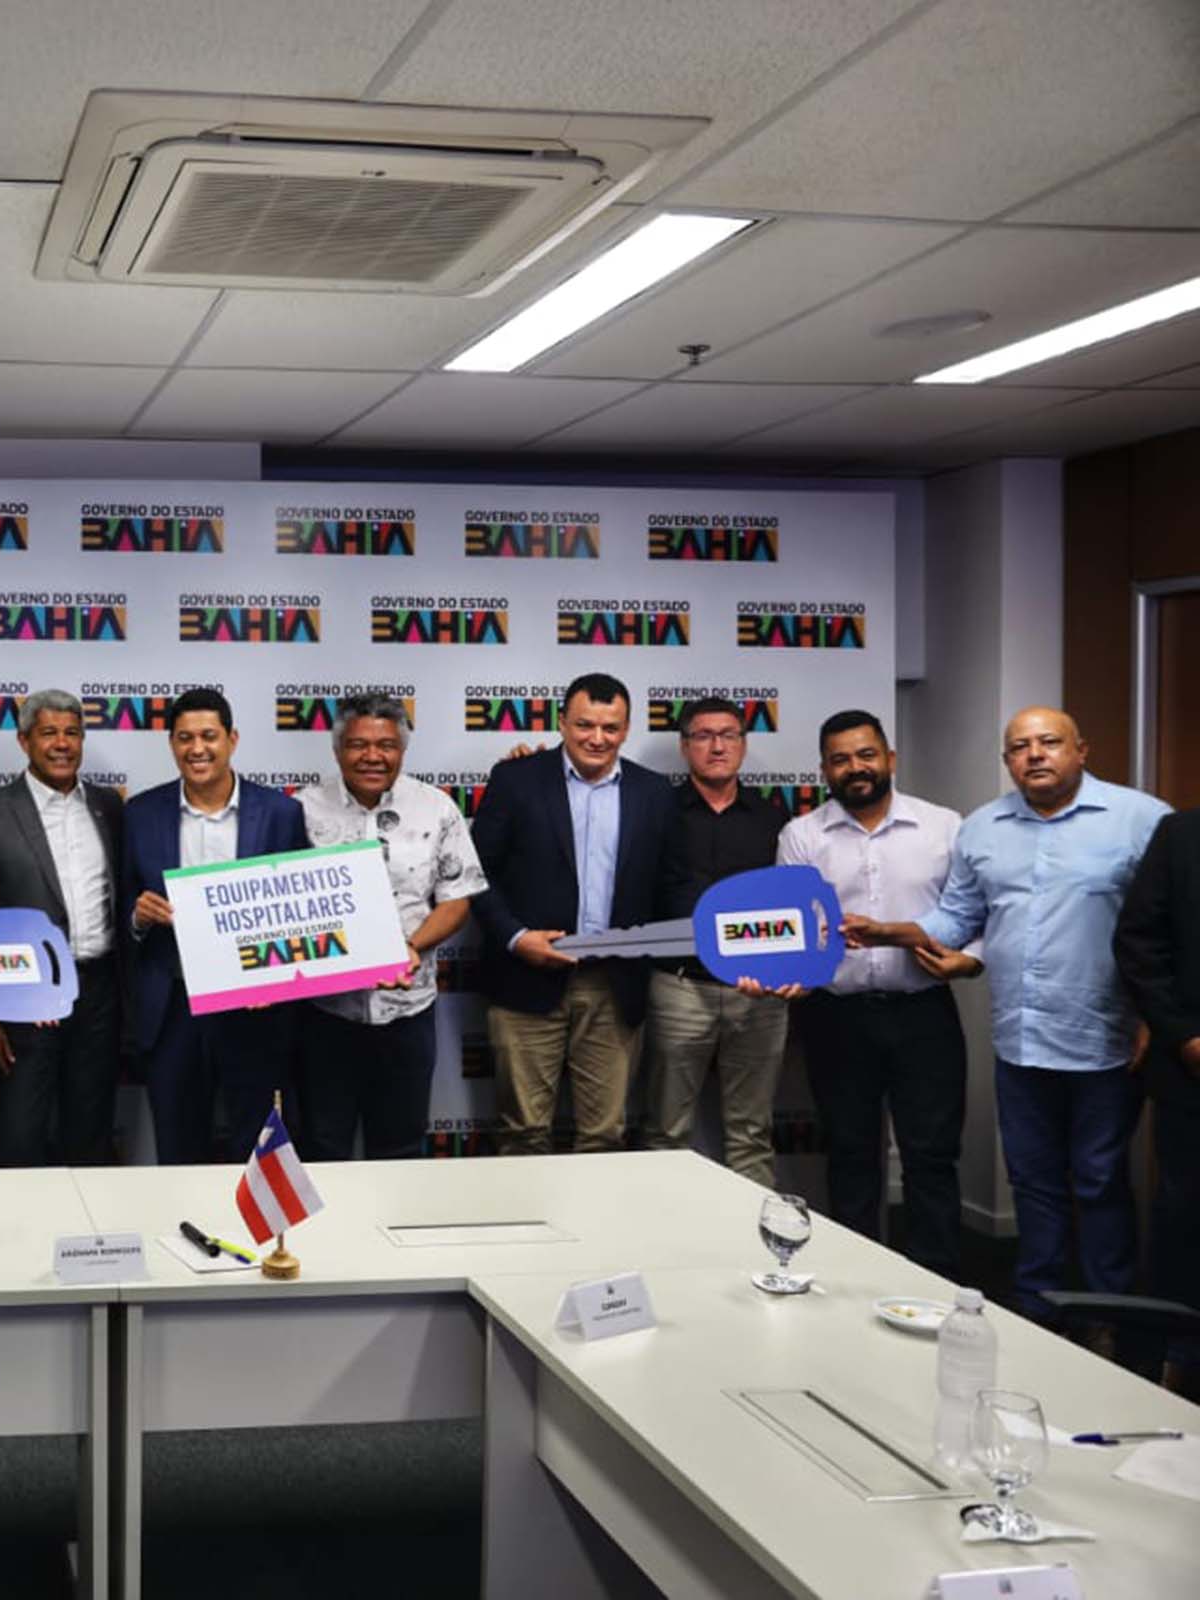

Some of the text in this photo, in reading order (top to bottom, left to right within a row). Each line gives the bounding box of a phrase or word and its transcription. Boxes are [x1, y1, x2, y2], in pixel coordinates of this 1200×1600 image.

[80, 503, 224, 516] GOVERNO DO ESTADO
[275, 507, 415, 520] GOVERNO DO ESTADO
[464, 510, 600, 523] GOVERNO DO ESTADO
[647, 514, 778, 527] GOVERNO DO ESTADO
[80, 517, 224, 552] BAHIA
[275, 520, 415, 555] BAHIA
[464, 523, 600, 558] BAHIA
[647, 527, 778, 562] BAHIA
[52, 592, 72, 605] DO
[76, 592, 127, 605] ESTADO
[179, 594, 320, 607] GOVERNO DO ESTADO
[370, 596, 509, 609] GOVERNO DO ESTADO
[556, 599, 690, 612] GOVERNO DO ESTADO
[736, 601, 866, 614] GOVERNO DO ESTADO
[179, 606, 320, 643] BAHIA
[370, 608, 509, 644] BAHIA
[556, 611, 690, 646] BAHIA
[736, 614, 866, 649] BAHIA
[80, 683, 147, 696] GOVERNO
[150, 683, 170, 696] DO
[275, 684, 340, 697] GOVERNO
[464, 685, 527, 698] GOVERNO
[530, 685, 548, 698] DO
[647, 687, 778, 700] GOVERNO DO ESTADO
[271, 772, 321, 785] ESTADO
[438, 772, 457, 785] DO
[800, 772, 818, 785] DO
[204, 865, 354, 908] EQUIPAMENTOS
[213, 892, 356, 934] HOSPITALARES
[235, 920, 344, 945] GOVERNO DO ESTADO
[722, 918, 797, 941] BAHIA
[237, 929, 349, 972] BAHIA
